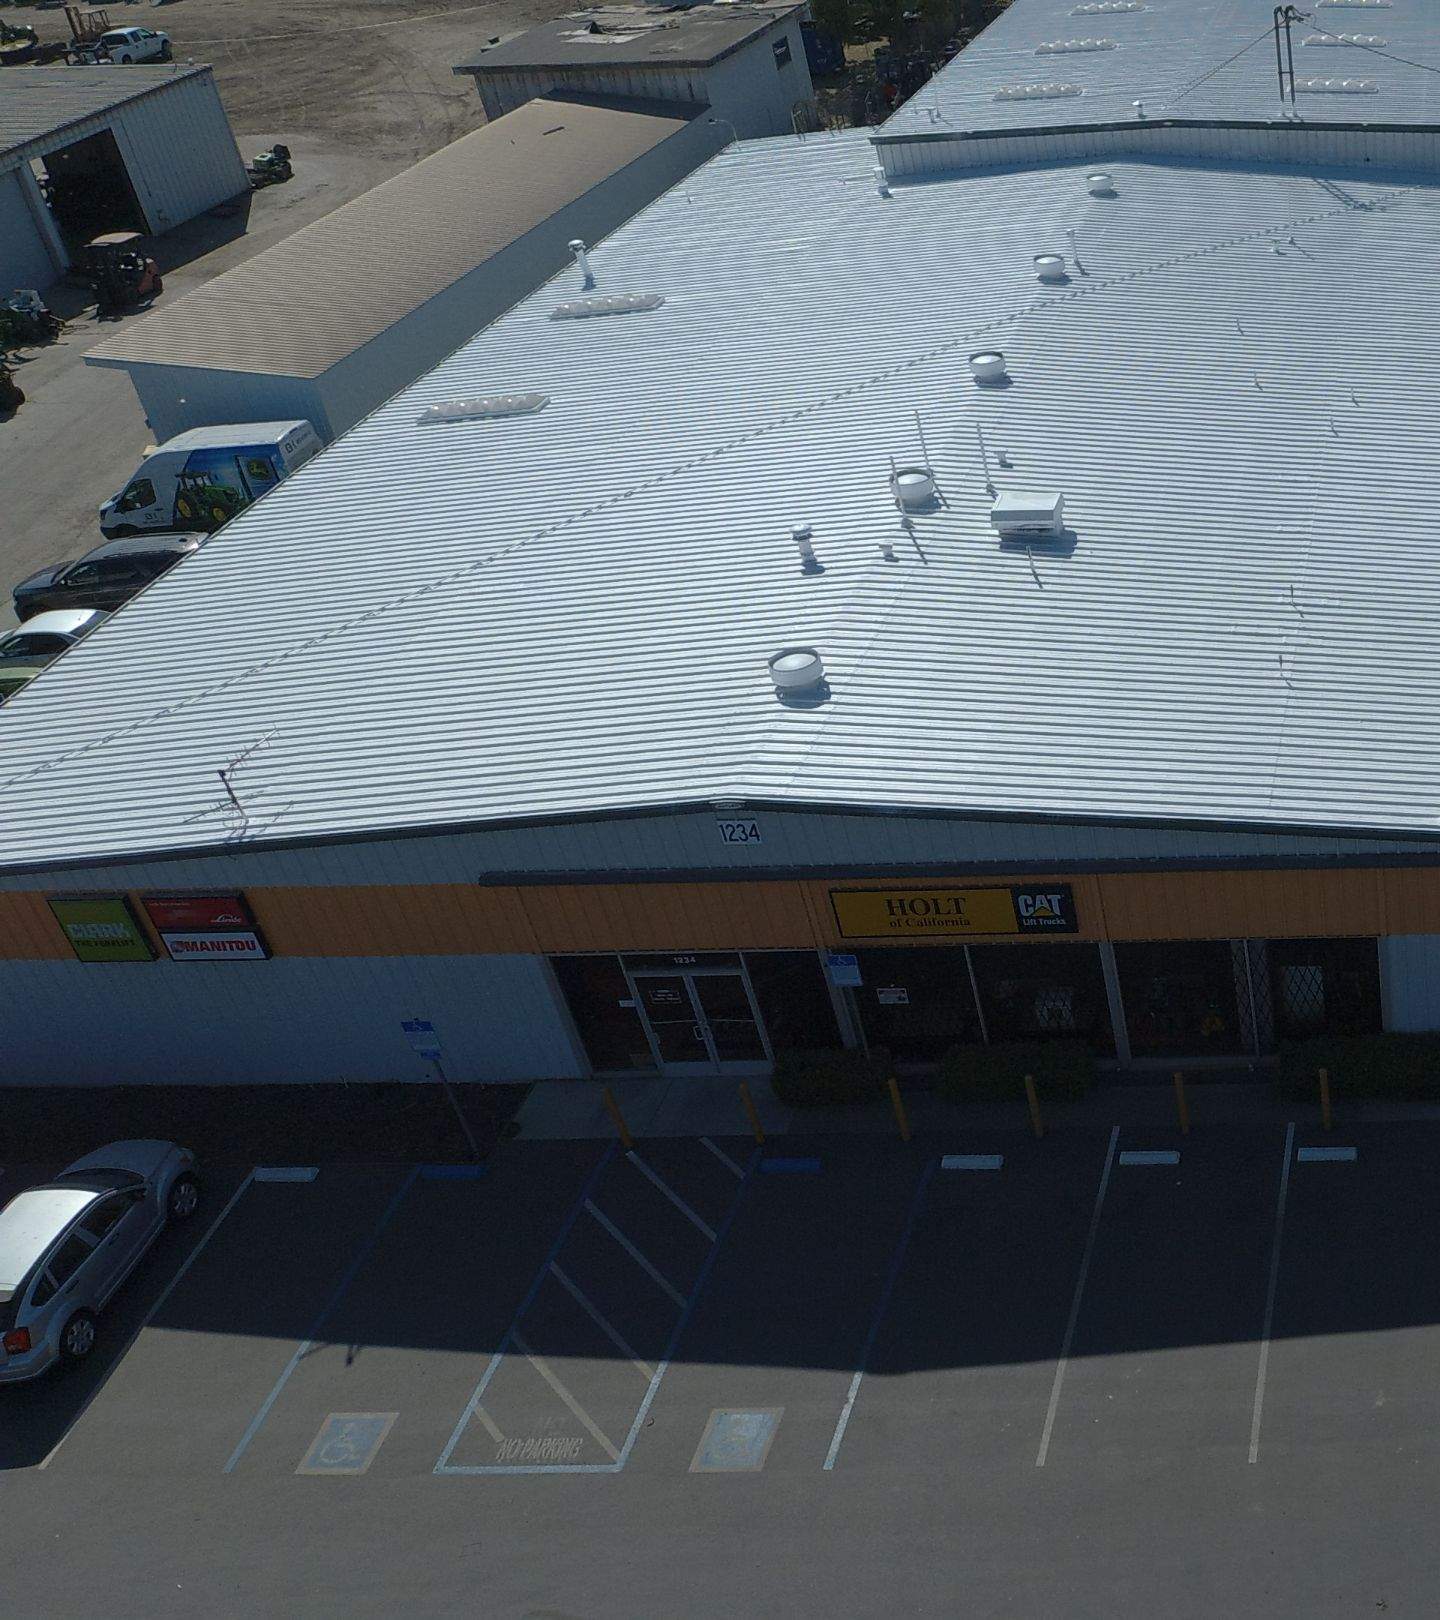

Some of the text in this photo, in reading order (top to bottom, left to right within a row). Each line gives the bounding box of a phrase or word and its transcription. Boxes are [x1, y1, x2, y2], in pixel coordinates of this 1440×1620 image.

[719, 823, 761, 842] 1234
[885, 897, 967, 916] HOLT
[1018, 894, 1063, 916] CAT
[889, 917, 971, 928] of California
[1022, 918, 1067, 926] Lift Trucks
[185, 940, 257, 952] MANITOU
[496, 1437, 584, 1461] NO PARKING
